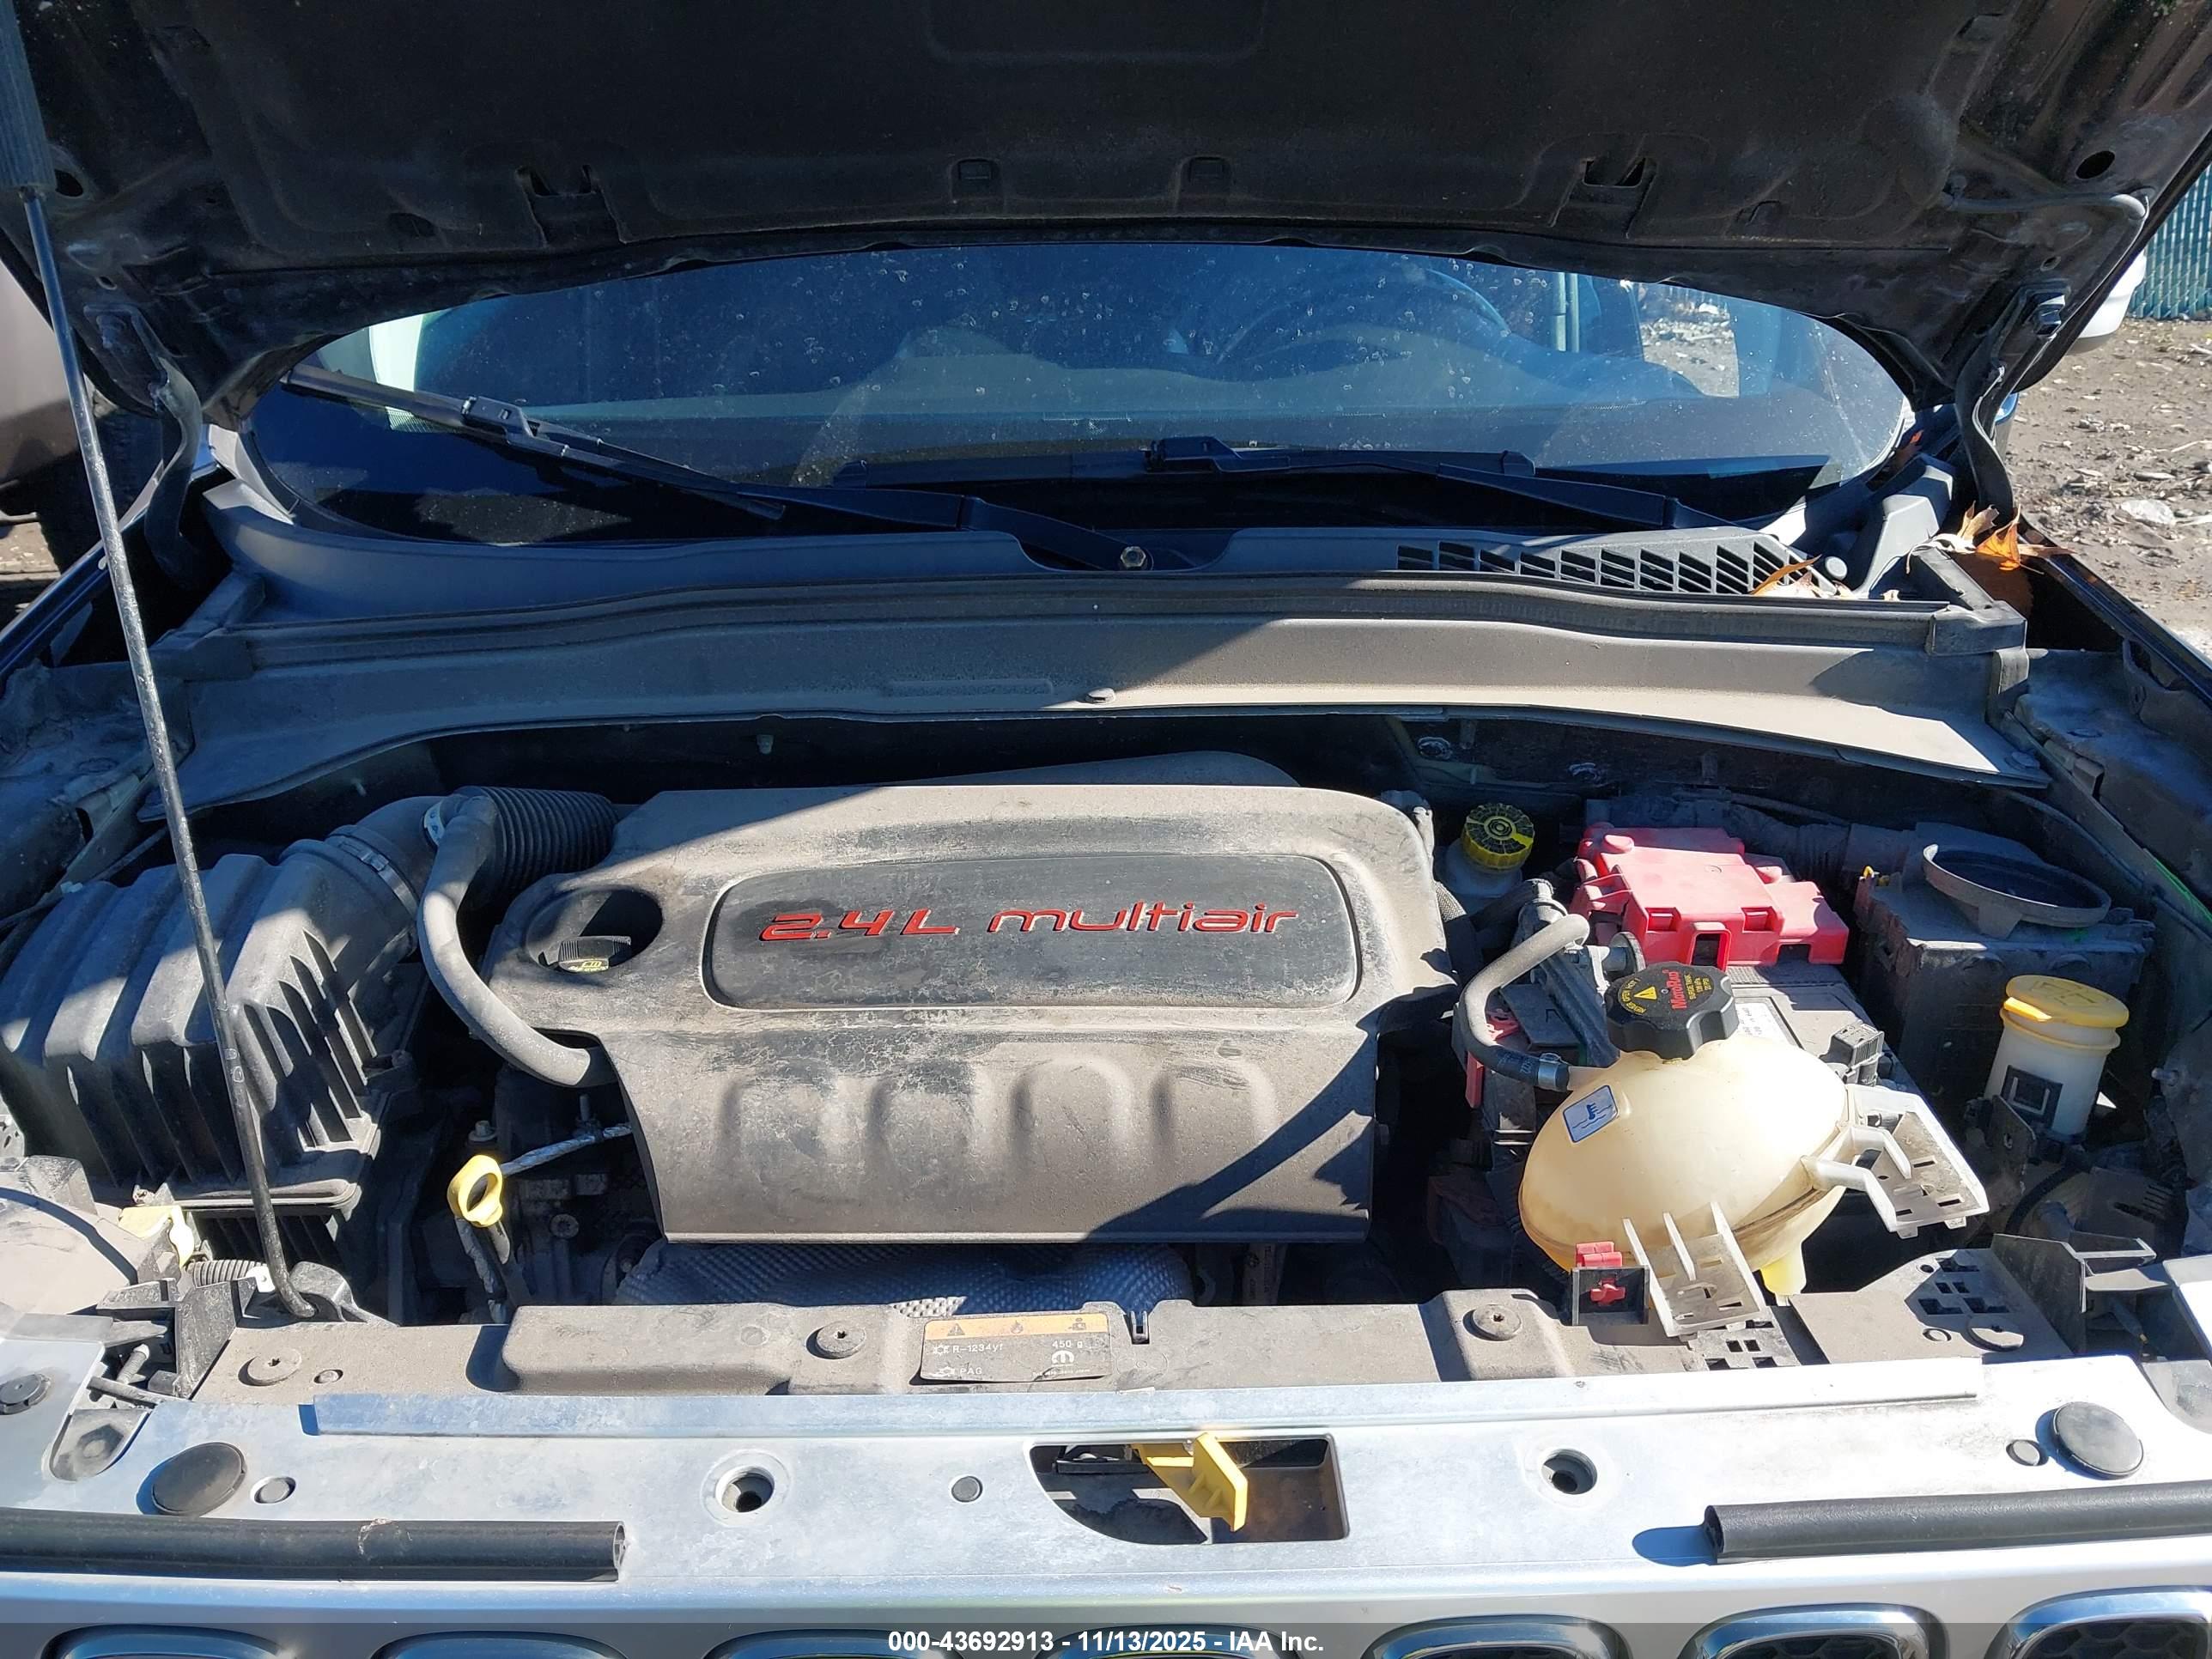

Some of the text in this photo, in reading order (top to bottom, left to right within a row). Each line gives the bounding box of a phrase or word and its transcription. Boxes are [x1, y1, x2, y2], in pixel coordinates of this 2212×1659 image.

[987, 900, 1298, 933] multiair
[1052, 1340, 1083, 1349] 450 g
